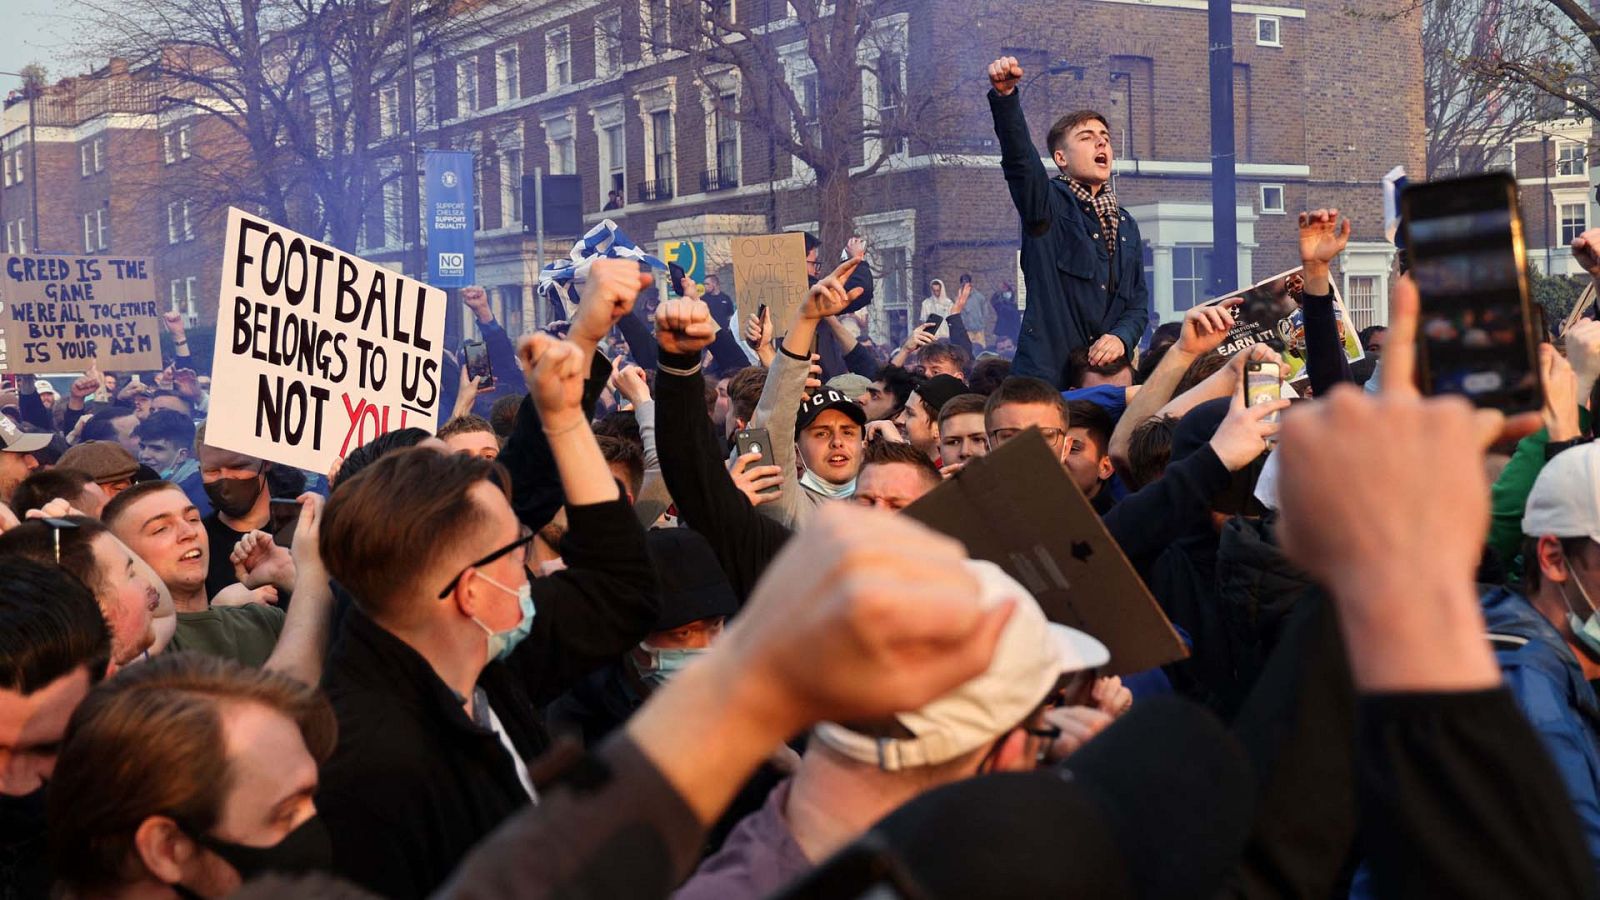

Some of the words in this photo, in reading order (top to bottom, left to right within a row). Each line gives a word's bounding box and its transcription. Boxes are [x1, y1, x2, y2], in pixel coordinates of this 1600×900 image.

[436, 202, 465, 210] SUPPORT
[741, 238, 785, 258] OUR
[7, 257, 70, 282] GREED
[75, 259, 102, 282] IS
[108, 259, 148, 280] THE
[441, 255, 462, 267] NO
[737, 262, 795, 285] VOICE
[45, 283, 94, 302] GAME
[235, 218, 431, 352] FOOTBALL
[60, 304, 85, 322] ALL
[89, 301, 158, 320] TOGETHER
[28, 323, 66, 338] BUT
[75, 321, 136, 339] MONEY
[1225, 321, 1260, 337] HAMPIONS
[24, 342, 51, 363] IS
[57, 340, 97, 360] YOUR
[110, 334, 152, 355] AIM
[232, 296, 348, 383] BELONGS
[357, 338, 387, 392] TO
[401, 352, 438, 409] US
[1217, 335, 1256, 356] EARN
[1256, 329, 1275, 342] IT!
[255, 374, 330, 451] NOT
